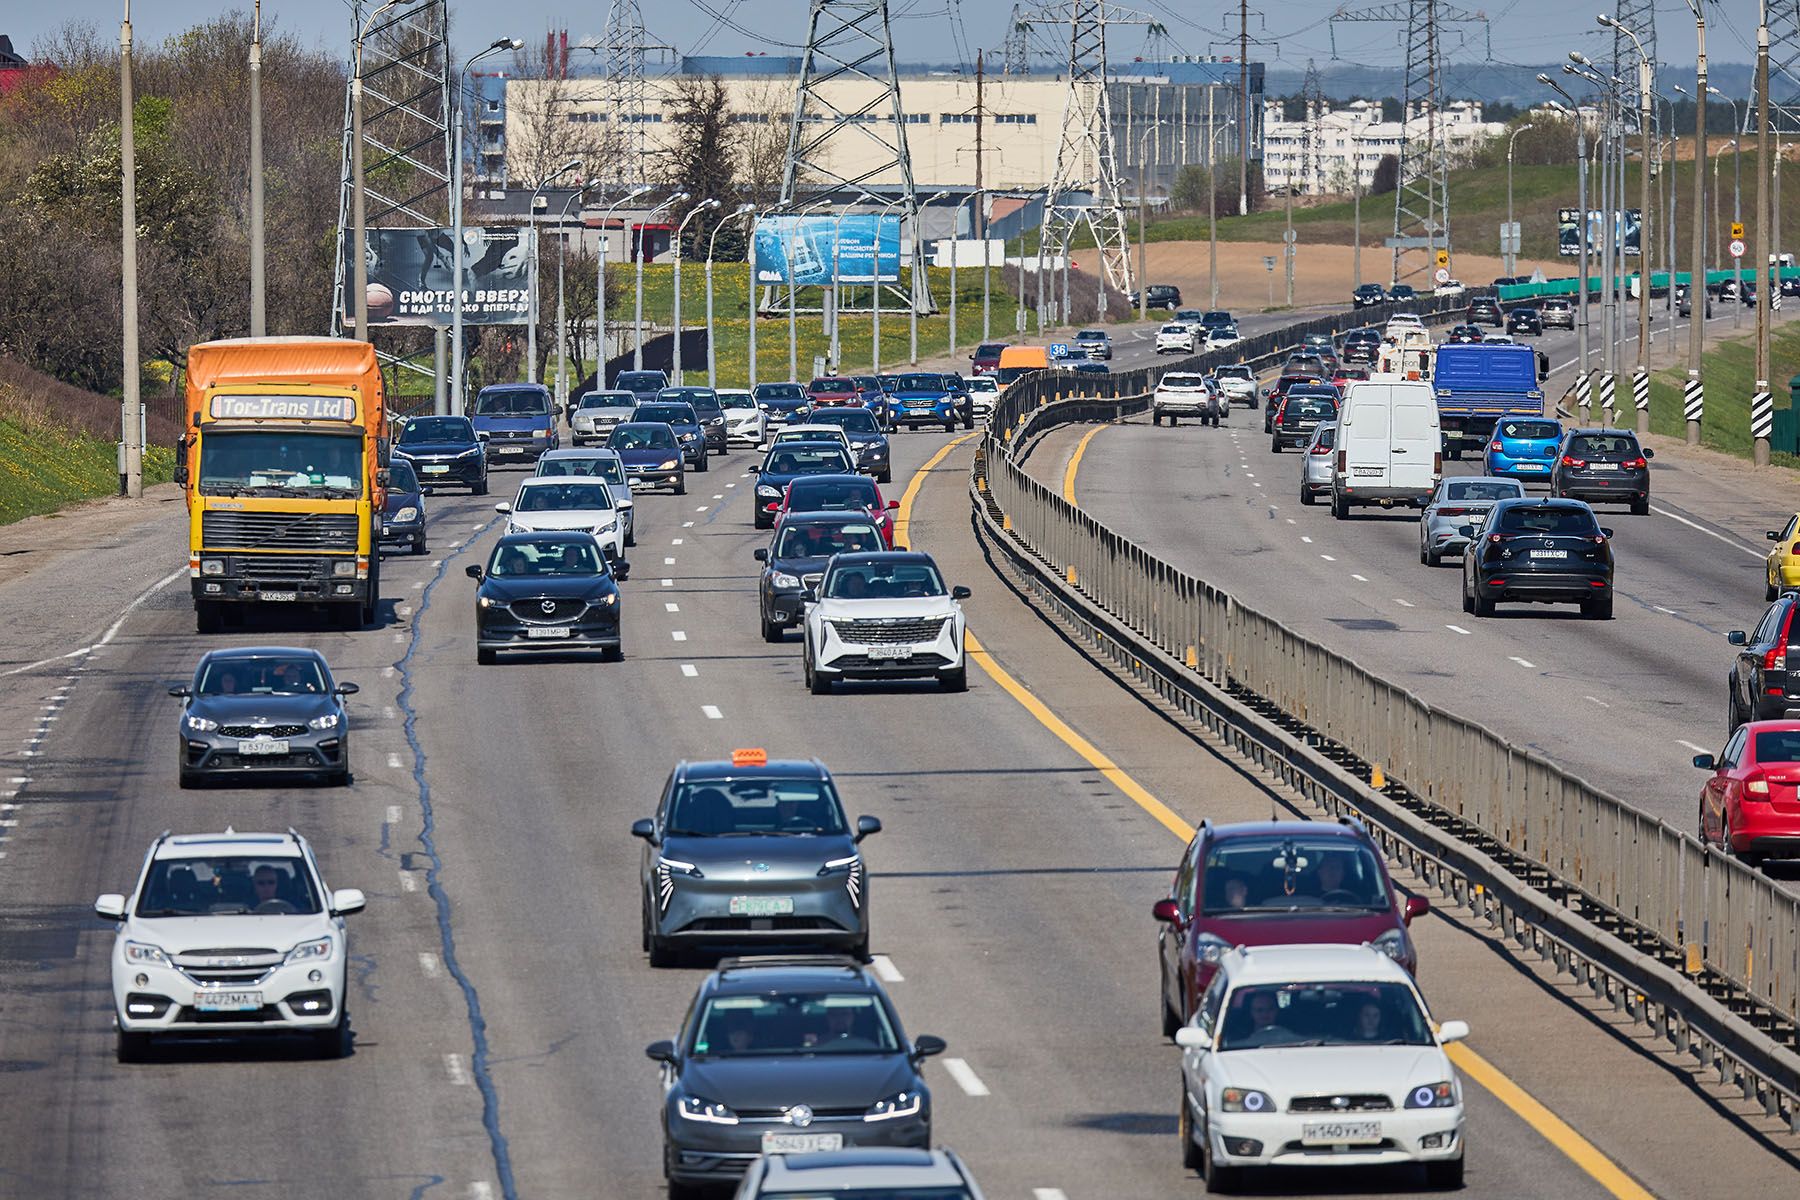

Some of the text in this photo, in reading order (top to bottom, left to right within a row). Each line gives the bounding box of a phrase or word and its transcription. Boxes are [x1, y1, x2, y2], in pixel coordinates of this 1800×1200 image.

[400, 304, 408, 313] И
[411, 304, 433, 314] ИДИ
[1052, 345, 1066, 355] 36
[224, 398, 341, 417] Tor-Trans Ltd
